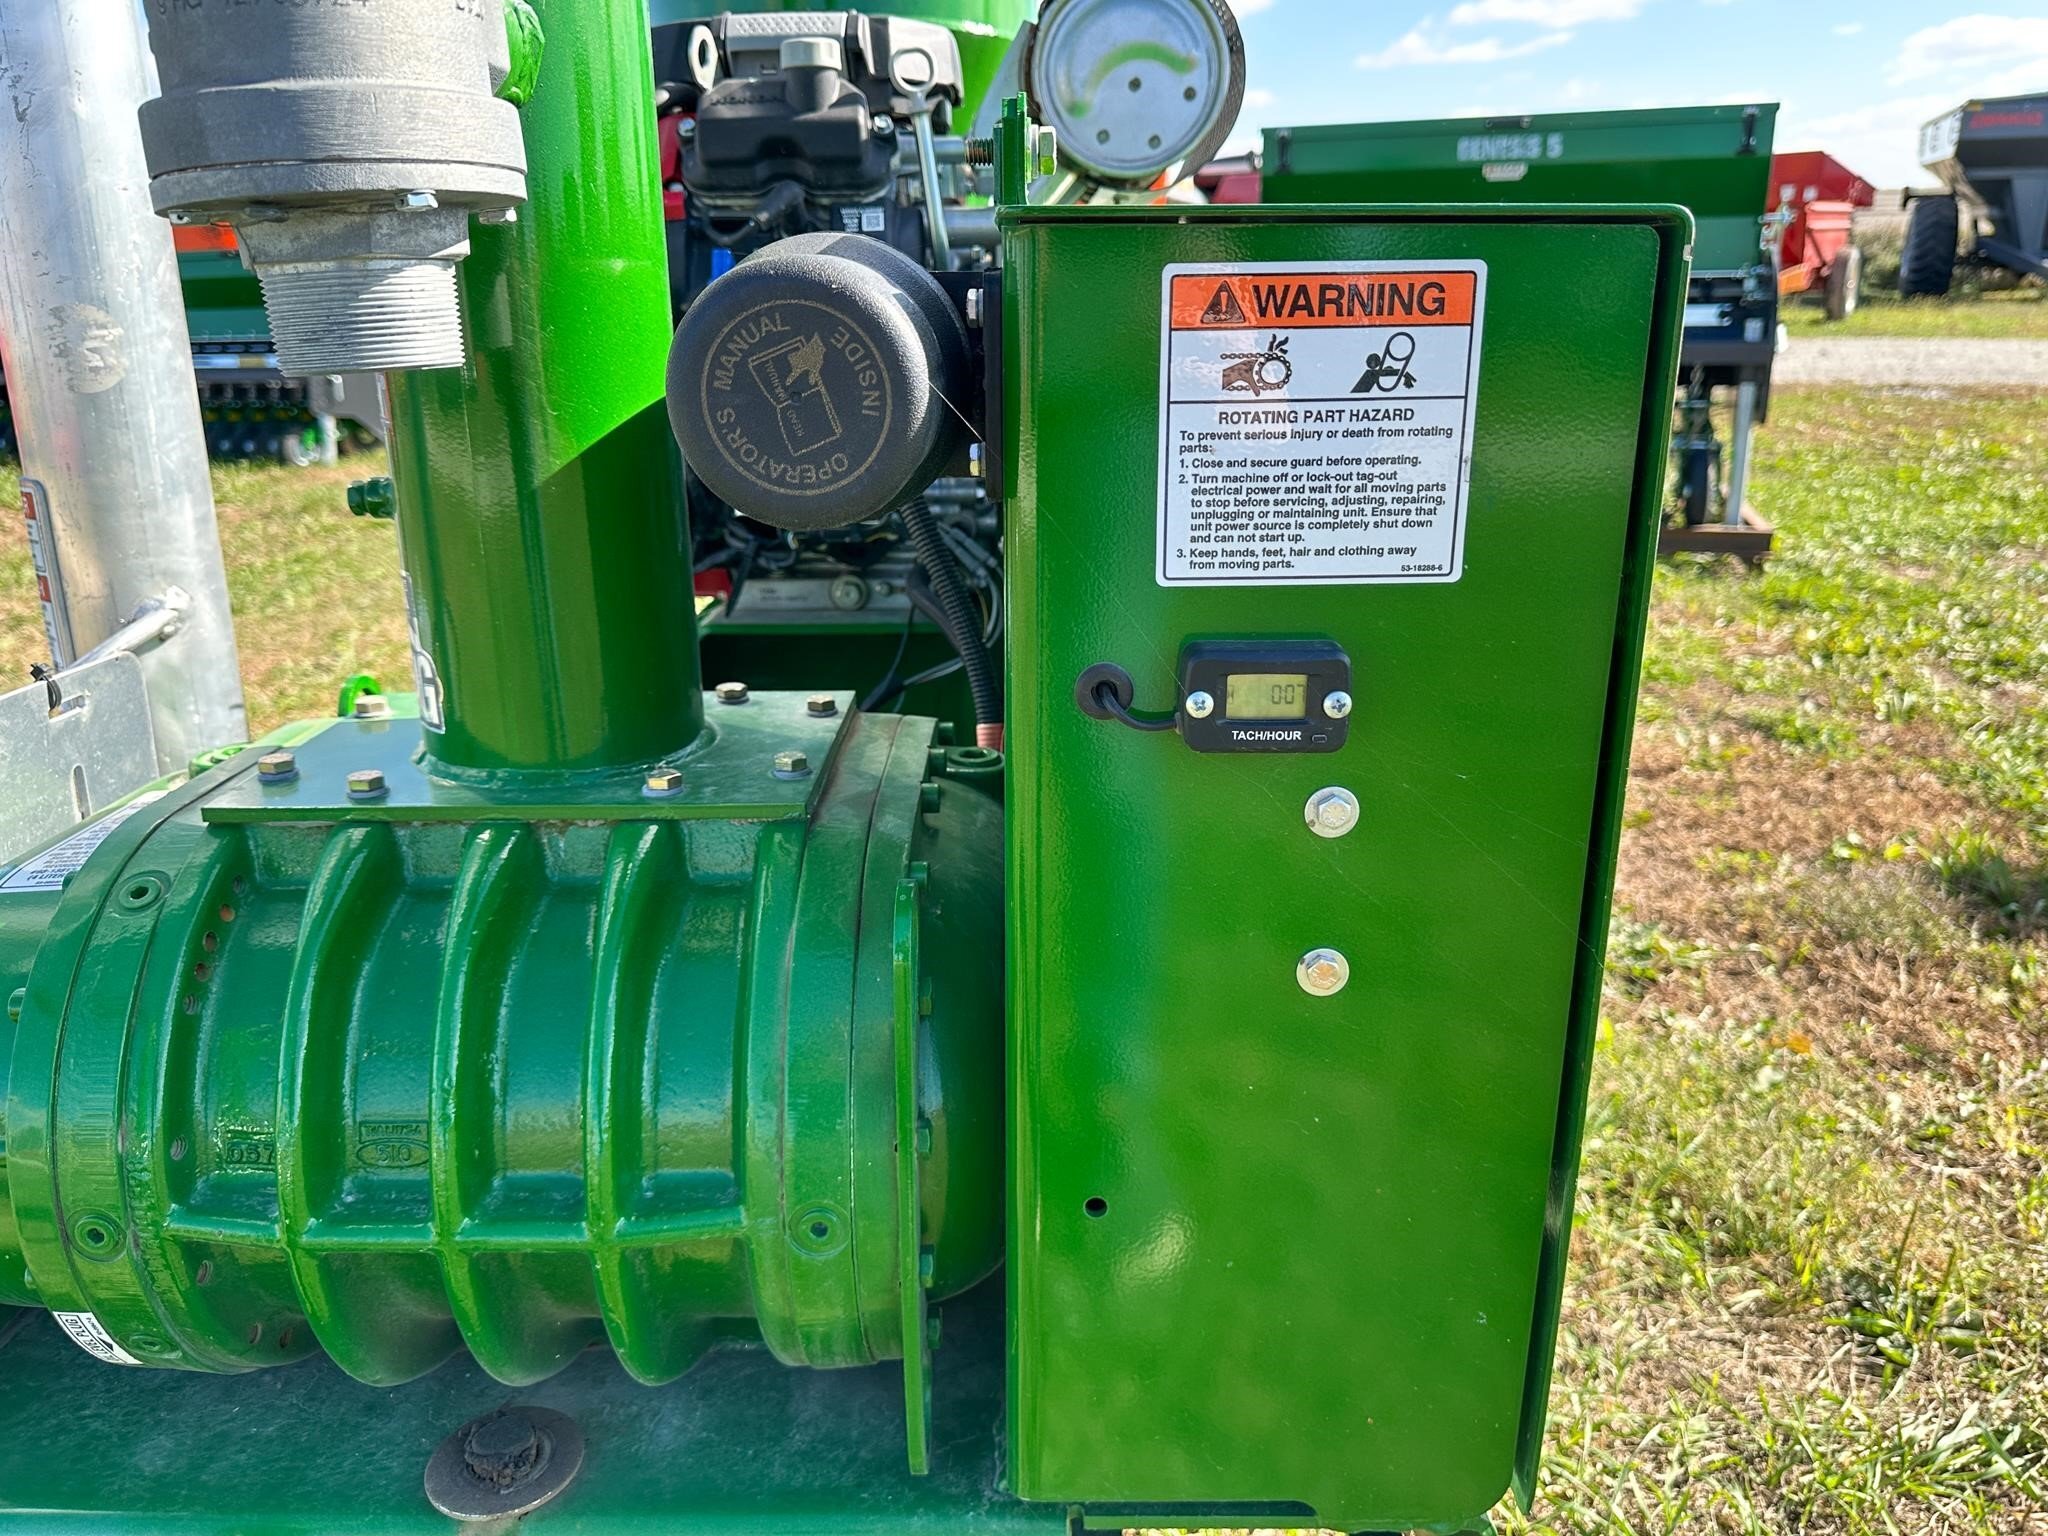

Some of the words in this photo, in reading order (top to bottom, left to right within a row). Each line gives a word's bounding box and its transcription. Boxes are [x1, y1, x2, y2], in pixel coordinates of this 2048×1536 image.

[1253, 281, 1446, 318] WARNING
[713, 313, 791, 390] MANUAL
[831, 326, 881, 416] INSIDE
[1219, 410, 1298, 425] ROTATING
[1304, 410, 1345, 423] PART
[1350, 408, 1414, 422] HAZARD
[1180, 431, 1194, 441] To
[1198, 431, 1241, 442] prevent
[1244, 430, 1287, 440] serious
[1291, 428, 1323, 441] injury
[1327, 429, 1338, 438] or
[1342, 428, 1373, 438] death
[1378, 427, 1404, 437] from
[1408, 426, 1453, 438] rotating
[717, 408, 848, 484] OPERATOR'S
[1179, 445, 1212, 455] parts:
[1180, 459, 1188, 468] 1.
[1192, 458, 1223, 468] Close
[1227, 458, 1247, 467] and
[1250, 459, 1287, 467] secure
[1291, 457, 1323, 469] guard
[1327, 456, 1361, 465] before
[1365, 455, 1421, 466] operating.
[1179, 474, 1188, 483] 2.
[1192, 474, 1218, 483] Turn
[1222, 473, 1269, 483] machine
[1273, 473, 1289, 482] off
[1292, 474, 1302, 482] or
[1307, 472, 1353, 482] lock-out
[1357, 471, 1397, 482] tag-out
[1191, 485, 1242, 496] electrical
[1246, 486, 1281, 497] power
[1284, 485, 1305, 494] and
[1309, 484, 1332, 494] wait
[1335, 484, 1351, 493] for
[1354, 483, 1369, 493] all
[1371, 483, 1413, 494] moving
[1417, 482, 1446, 494] parts
[1191, 498, 1202, 507] to
[1206, 498, 1230, 509] stop
[1234, 497, 1270, 507] before
[1273, 496, 1327, 508] servicing,
[1332, 495, 1387, 506] adjusting,
[1391, 495, 1445, 505] repairing,
[1191, 509, 1254, 521] unplugging
[1258, 510, 1270, 519] or
[1273, 508, 1339, 519] maintaining
[1343, 507, 1367, 517] unit.
[1372, 507, 1411, 517] Ensure
[1415, 507, 1437, 515] that
[1191, 521, 1212, 531] unit
[1215, 522, 1249, 533] power
[1253, 522, 1291, 530] source
[1295, 521, 1304, 530] is
[1308, 519, 1369, 531] completely
[1373, 519, 1398, 528] shut
[1402, 519, 1432, 528] down
[1190, 533, 1211, 543] and
[1214, 534, 1234, 542] can
[1238, 533, 1256, 542] not
[1259, 533, 1284, 542] start
[1288, 534, 1304, 544] up.
[1177, 549, 1186, 558] 3.
[1190, 548, 1218, 559] Keep
[1221, 548, 1259, 558] hands,
[1263, 547, 1286, 557] feet,
[1290, 547, 1311, 557] hair
[1314, 546, 1336, 556] and
[1338, 545, 1384, 557] clothing
[1388, 546, 1417, 556] away
[1190, 560, 1215, 569] from
[1219, 559, 1259, 570] moving
[1263, 560, 1294, 570] parts.
[1232, 731, 1301, 740] TACH/HOUR
[65, 1318, 89, 1338] PLUG
